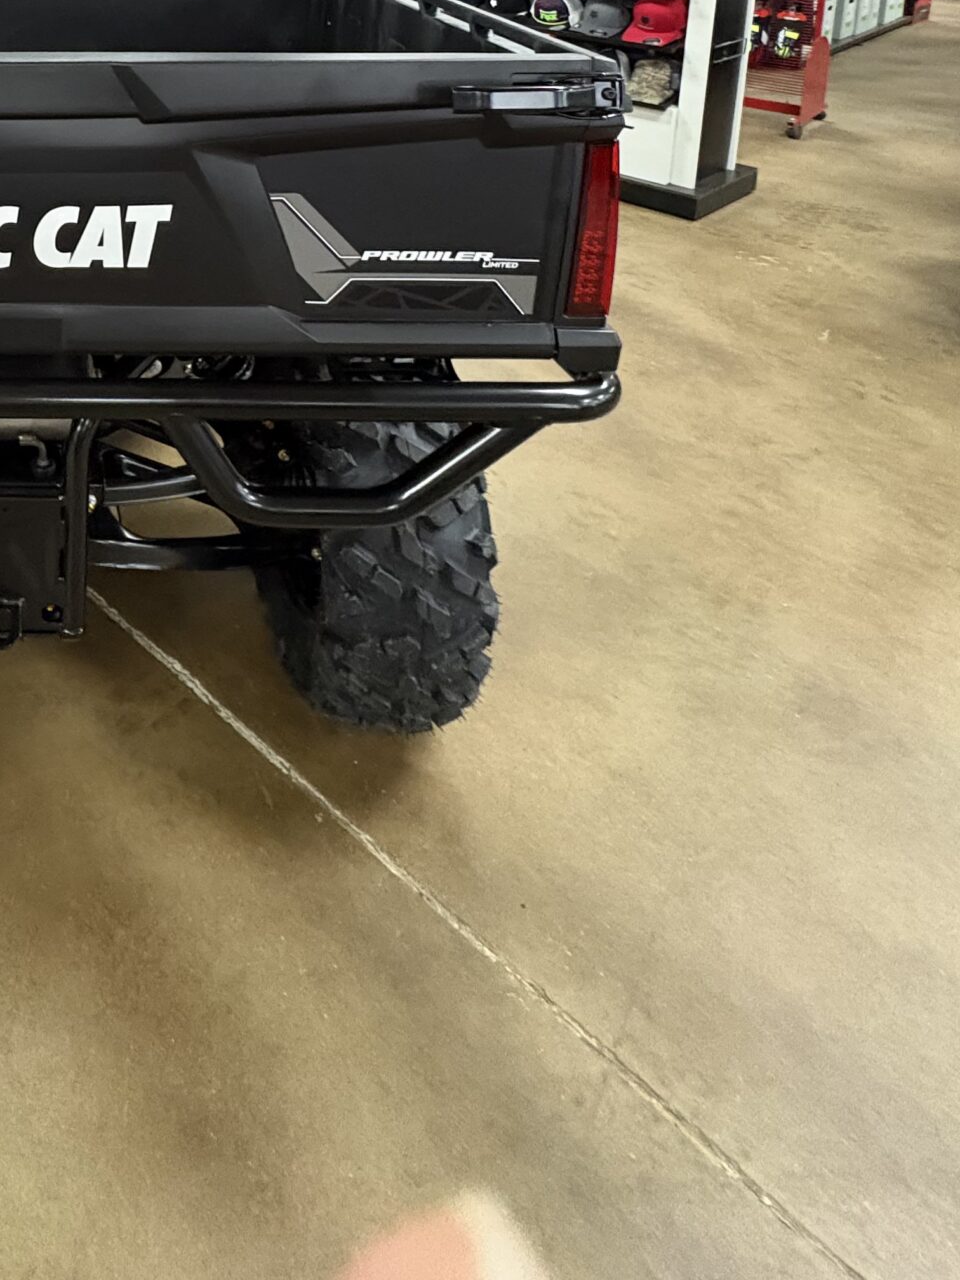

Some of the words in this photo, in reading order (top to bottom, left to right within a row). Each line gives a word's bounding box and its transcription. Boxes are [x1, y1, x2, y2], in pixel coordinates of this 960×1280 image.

[33, 204, 173, 268] CAT
[361, 250, 494, 262] PROWLER
[482, 261, 519, 269] LIMITED
